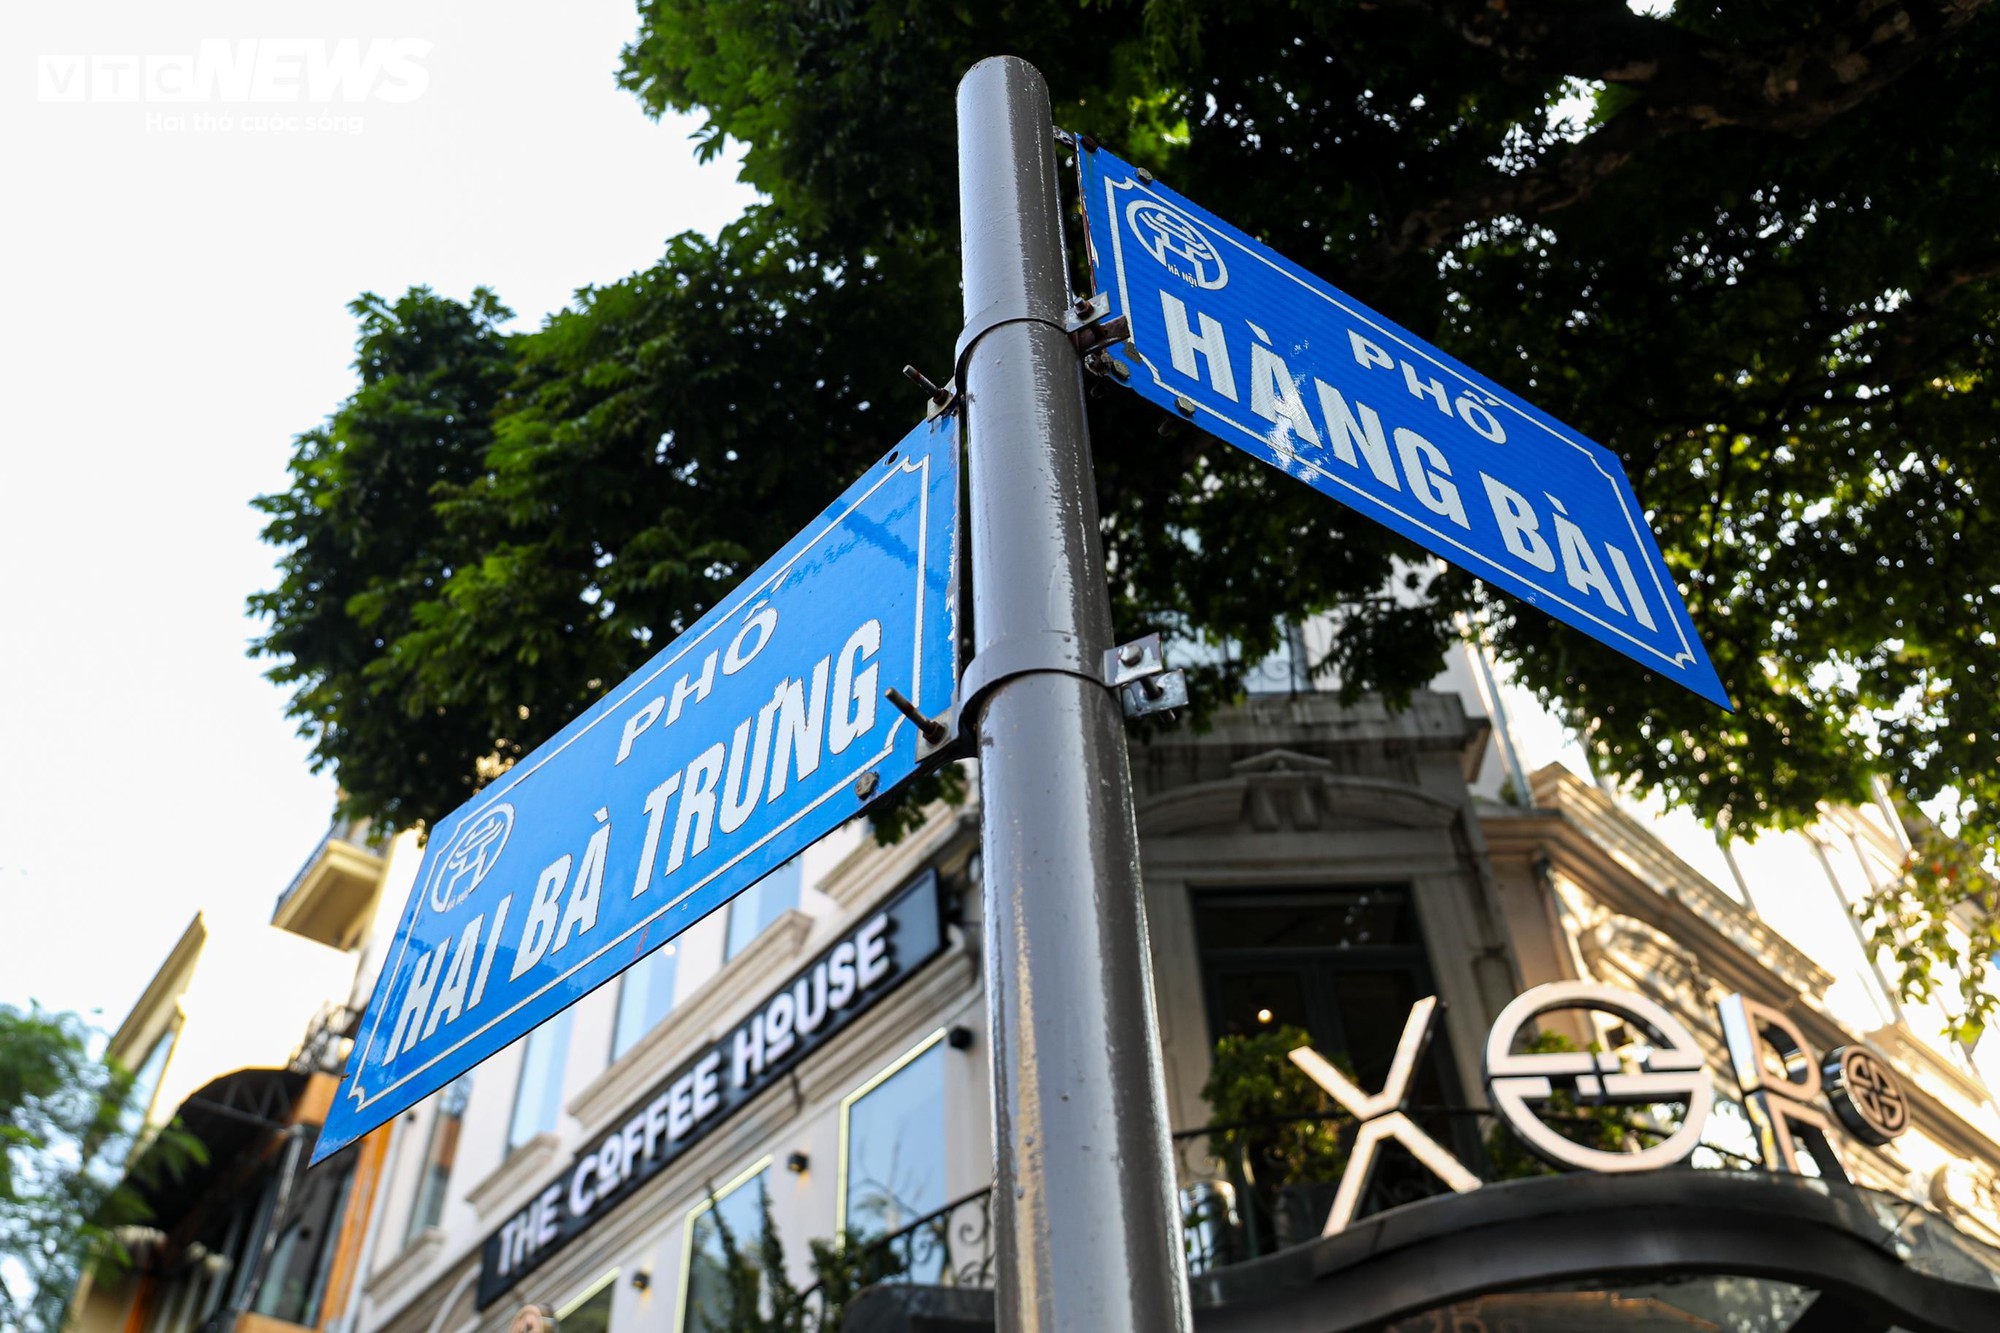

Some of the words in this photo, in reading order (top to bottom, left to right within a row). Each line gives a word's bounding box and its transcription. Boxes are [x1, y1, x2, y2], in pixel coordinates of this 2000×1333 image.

[1167, 264, 1180, 278] HÀ
[1346, 328, 1507, 445] PHỐ
[1159, 288, 1471, 532] HÀNG
[1479, 470, 1659, 633] BÀI
[614, 567, 794, 767] PHỐ
[381, 894, 513, 1068] HAI
[508, 806, 612, 984] BÀ
[630, 618, 882, 900] TRƯNG
[498, 1183, 562, 1277] THE
[569, 1050, 721, 1218] COFFEE
[731, 912, 891, 1088] HOUSE
